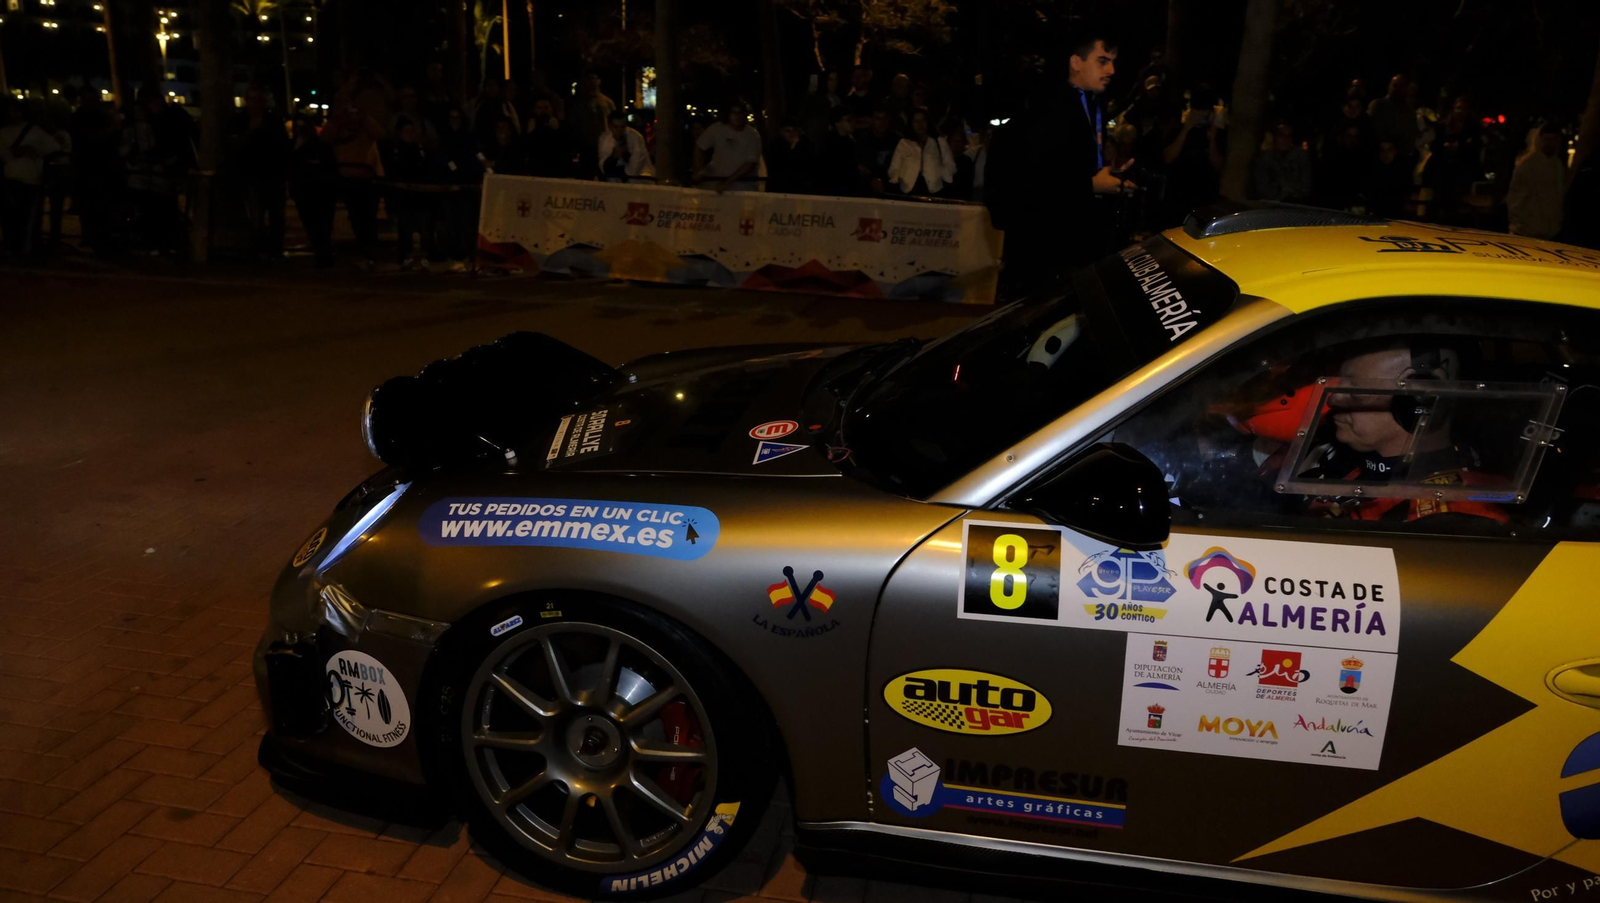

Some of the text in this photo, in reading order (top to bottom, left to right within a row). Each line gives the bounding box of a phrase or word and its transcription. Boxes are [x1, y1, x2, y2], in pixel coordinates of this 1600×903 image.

[543, 195, 606, 213] ALMERÍA
[656, 218, 672, 229] DE
[657, 210, 715, 223] DEPORTES
[768, 212, 835, 229] ALMERÍA
[890, 235, 907, 245] DE
[891, 226, 953, 239] DEPORTES
[1137, 271, 1202, 342] ALMERÍA
[448, 502, 686, 525] TUS PEDIDOS EN UN CLIC
[440, 517, 675, 549] www.emmex.es
[988, 533, 1029, 611] 8
[1264, 576, 1384, 602] COSTA DE
[1094, 601, 1143, 621] 30 AÑOS
[1120, 612, 1155, 623] CONTIGO
[1238, 601, 1386, 637] ALMERÍA
[752, 614, 841, 638] LA ESPAÑOLA
[1134, 663, 1183, 674] DIPUTACIÓN
[1146, 672, 1181, 681] ALMERÍA
[903, 677, 1036, 712] auto
[1196, 681, 1237, 691] ALMERÍA
[1256, 688, 1297, 697] DEPORTES
[335, 707, 407, 743] UNCTIONAL FITNESS
[964, 707, 1030, 730] gar
[1197, 713, 1279, 740] MOYA
[1292, 713, 1374, 738] Andalucía
[943, 758, 1129, 802] IMPRESUR
[965, 794, 1104, 820] artes gráficas
[610, 835, 714, 892] MICHELIN
[1530, 885, 1560, 902] Por
[1566, 882, 1576, 895] y
